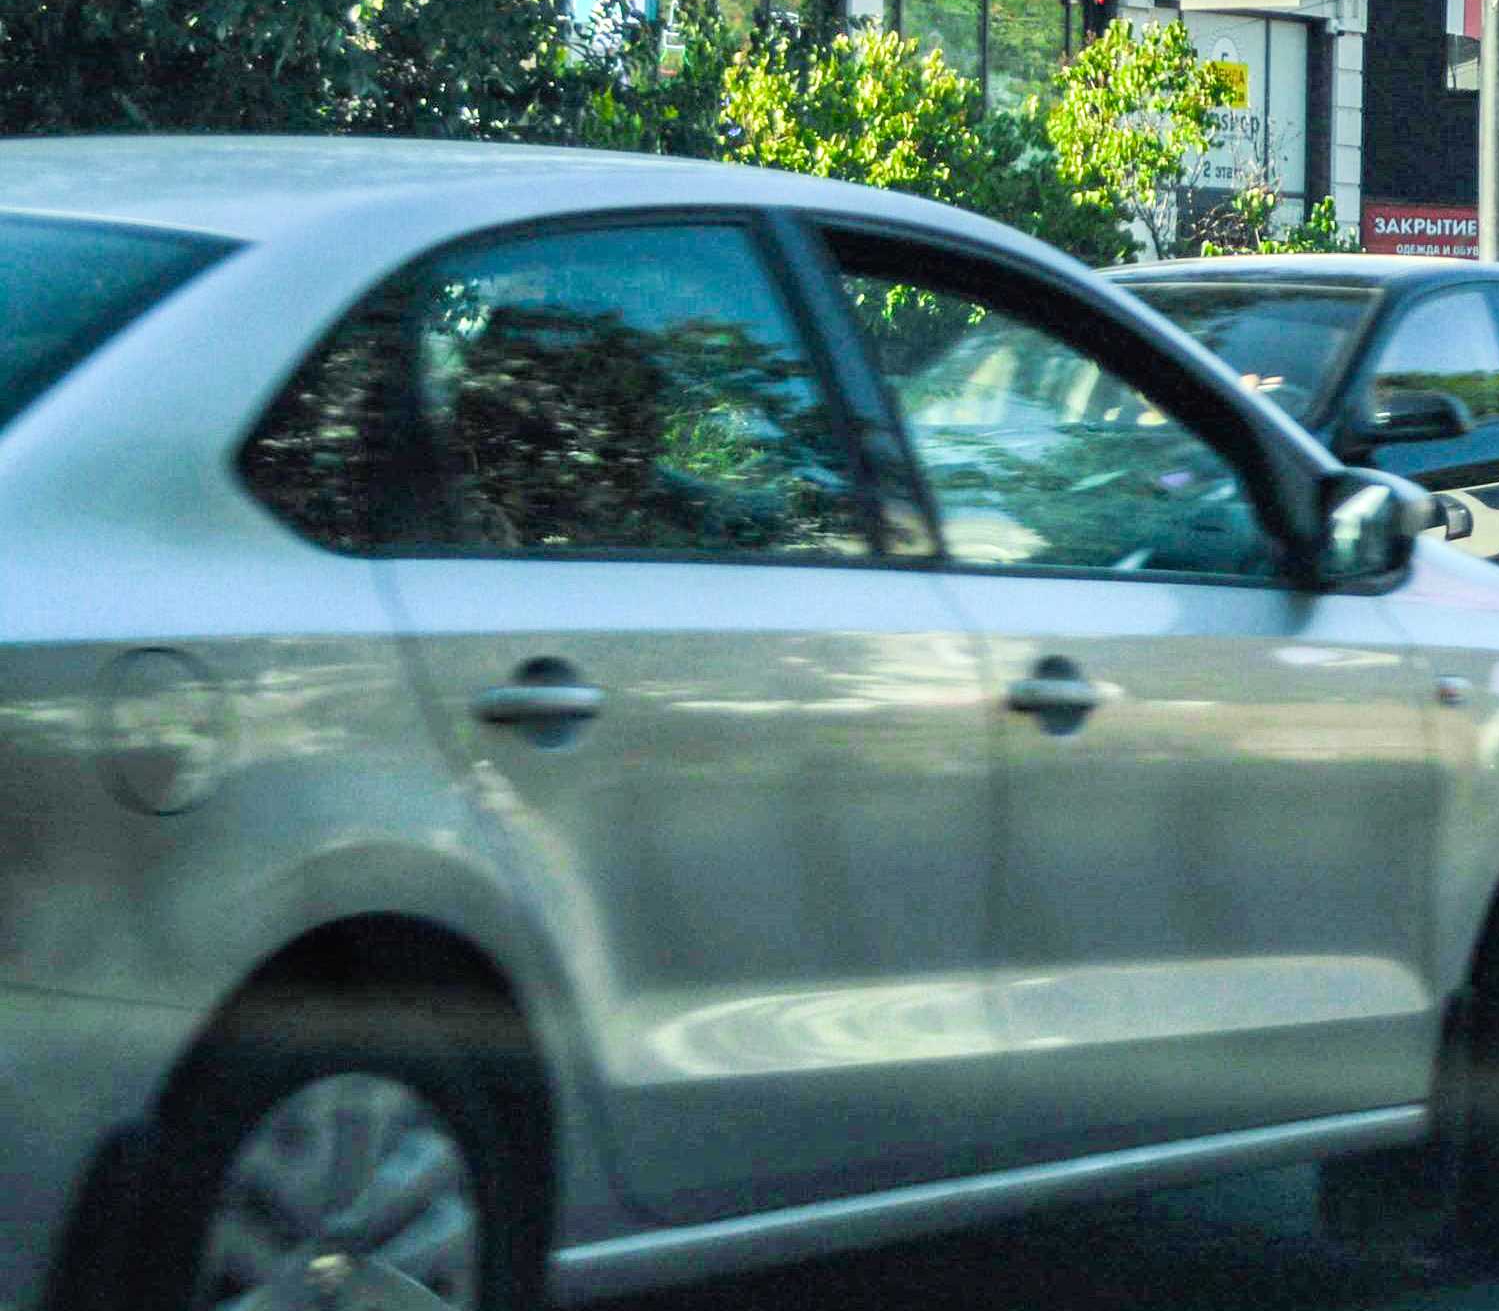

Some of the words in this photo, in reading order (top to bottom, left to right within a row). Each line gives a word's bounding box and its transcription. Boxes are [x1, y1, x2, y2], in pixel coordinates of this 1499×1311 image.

[1375, 216, 1478, 237] ЗАКРЫТИЕ
[1396, 243, 1440, 256] ОДЕЖДА
[1453, 245, 1480, 258] ОБУВ
